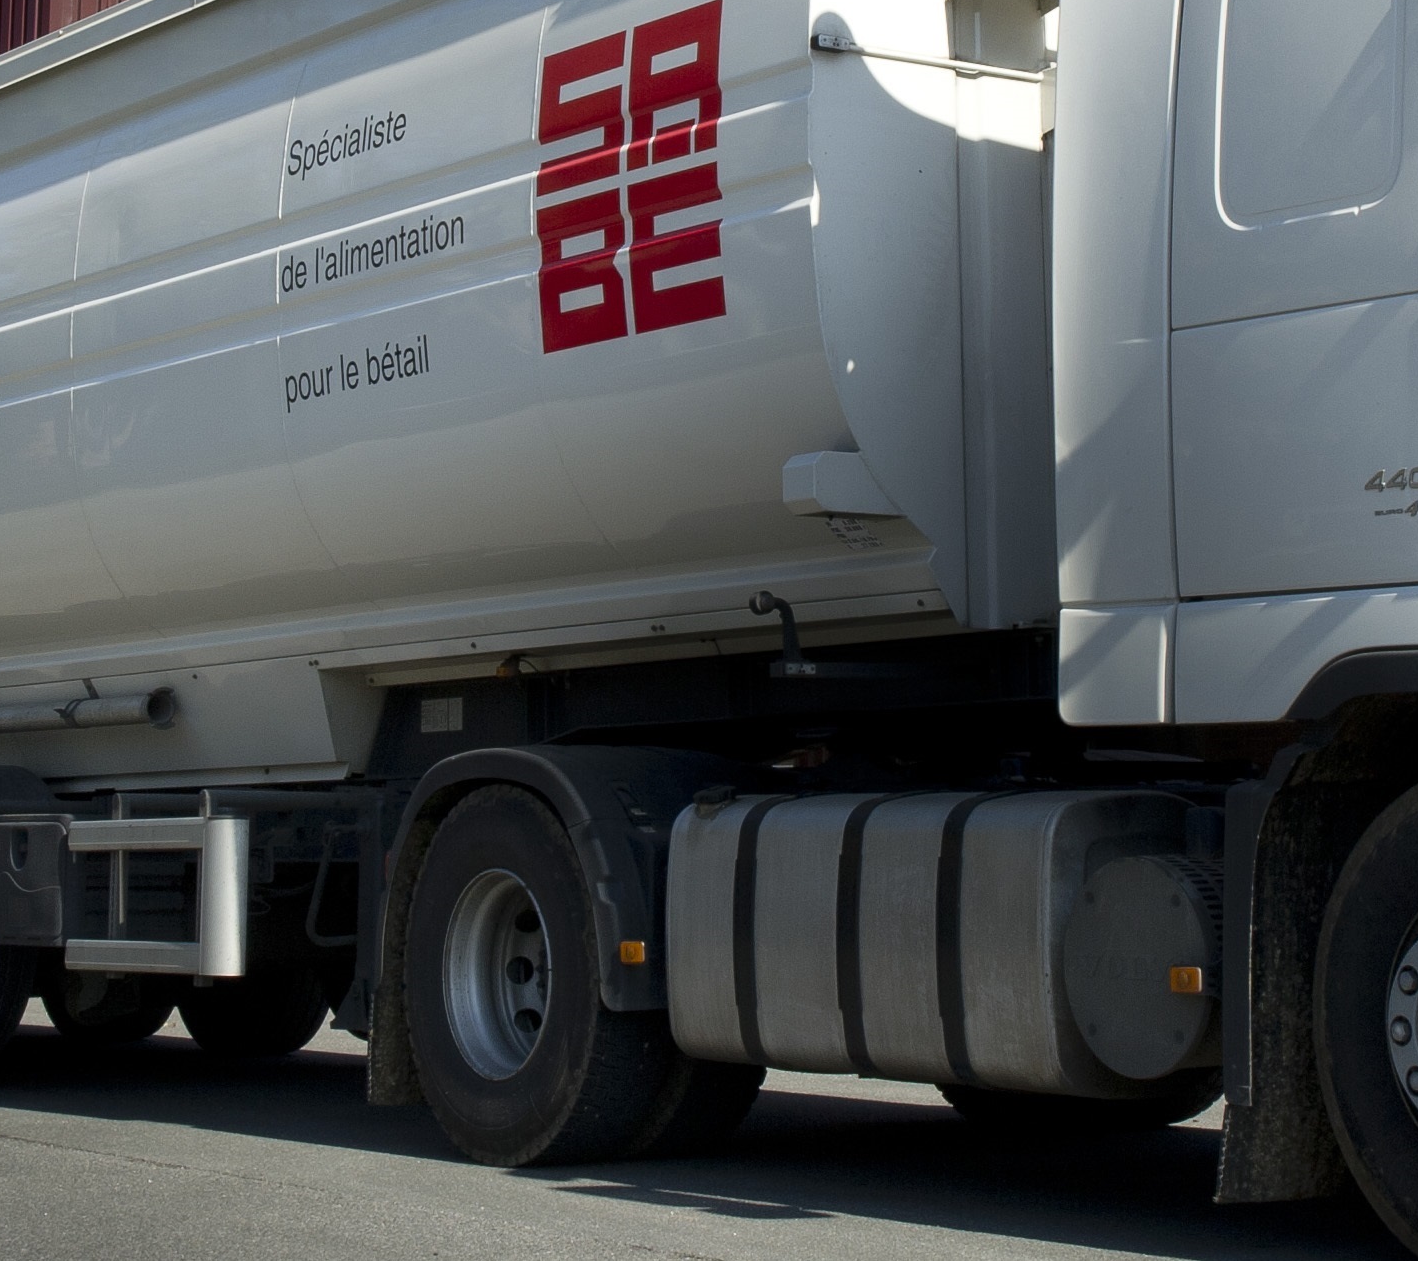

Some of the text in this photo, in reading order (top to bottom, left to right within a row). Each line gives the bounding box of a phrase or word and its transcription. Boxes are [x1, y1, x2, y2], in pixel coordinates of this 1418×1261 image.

[287, 111, 407, 181] Spécialiste
[281, 214, 464, 292] de l'alimentation
[285, 334, 429, 413] pour le bétail
